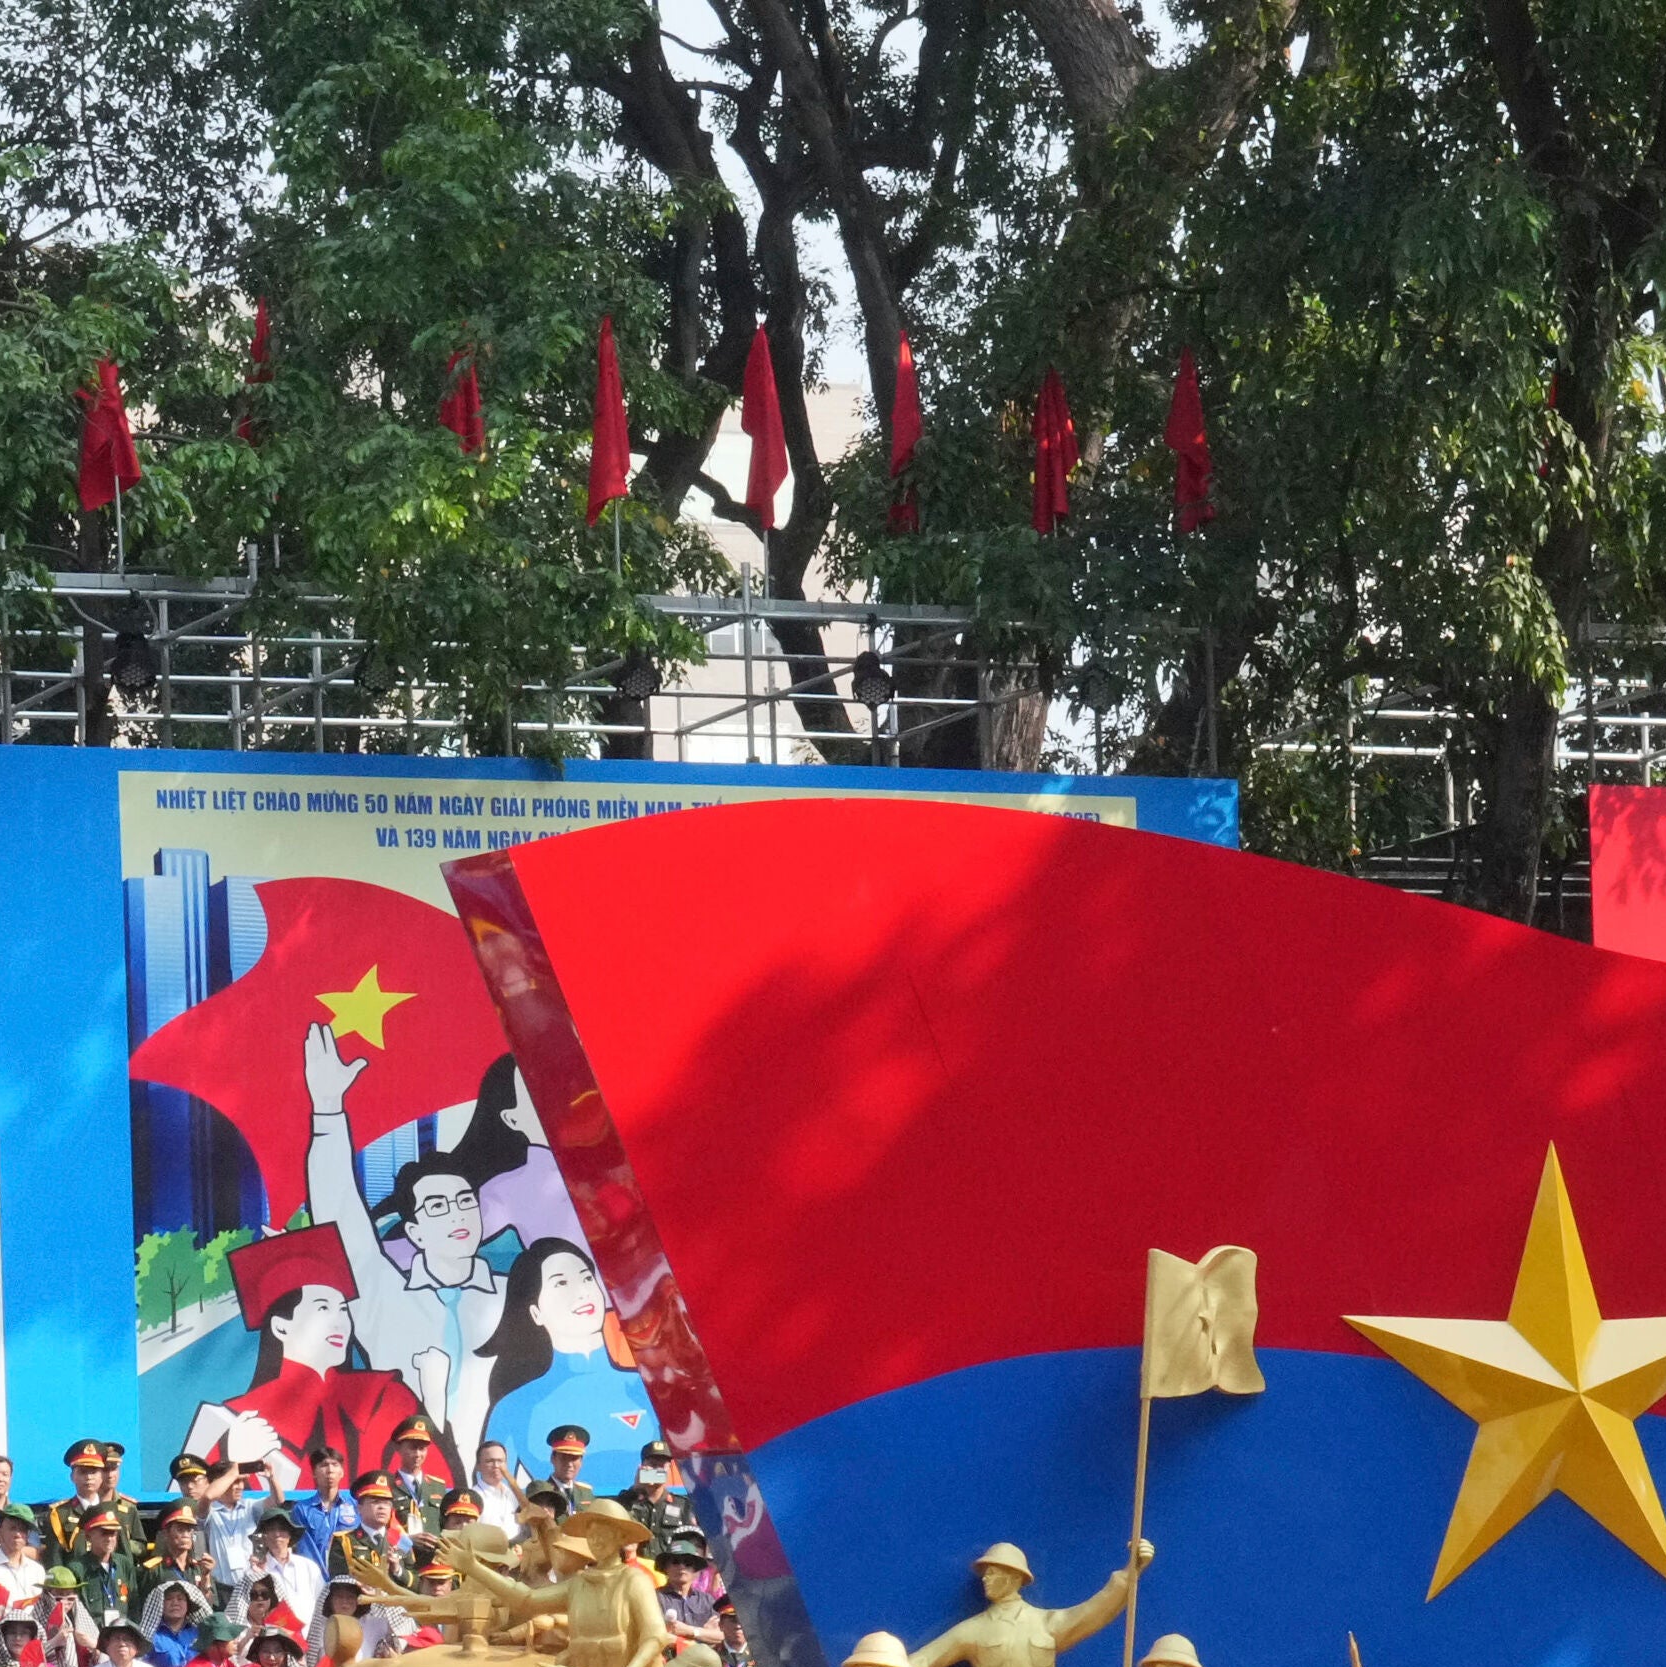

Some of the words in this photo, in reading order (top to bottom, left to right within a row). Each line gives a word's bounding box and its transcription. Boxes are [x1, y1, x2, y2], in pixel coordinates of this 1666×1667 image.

[156, 786, 207, 813] NHIỆT
[212, 787, 247, 814] LIỆT
[253, 788, 301, 812] CHÀO
[307, 789, 359, 814] MỪNG
[365, 794, 389, 814] 50
[394, 792, 433, 815] NĂM
[439, 792, 485, 816] NGÀY
[532, 796, 591, 819] PHÓNG
[597, 793, 639, 820] MIỀN
[375, 825, 400, 848] VÀ
[405, 828, 437, 849] 139
[442, 826, 482, 850] NĂM
